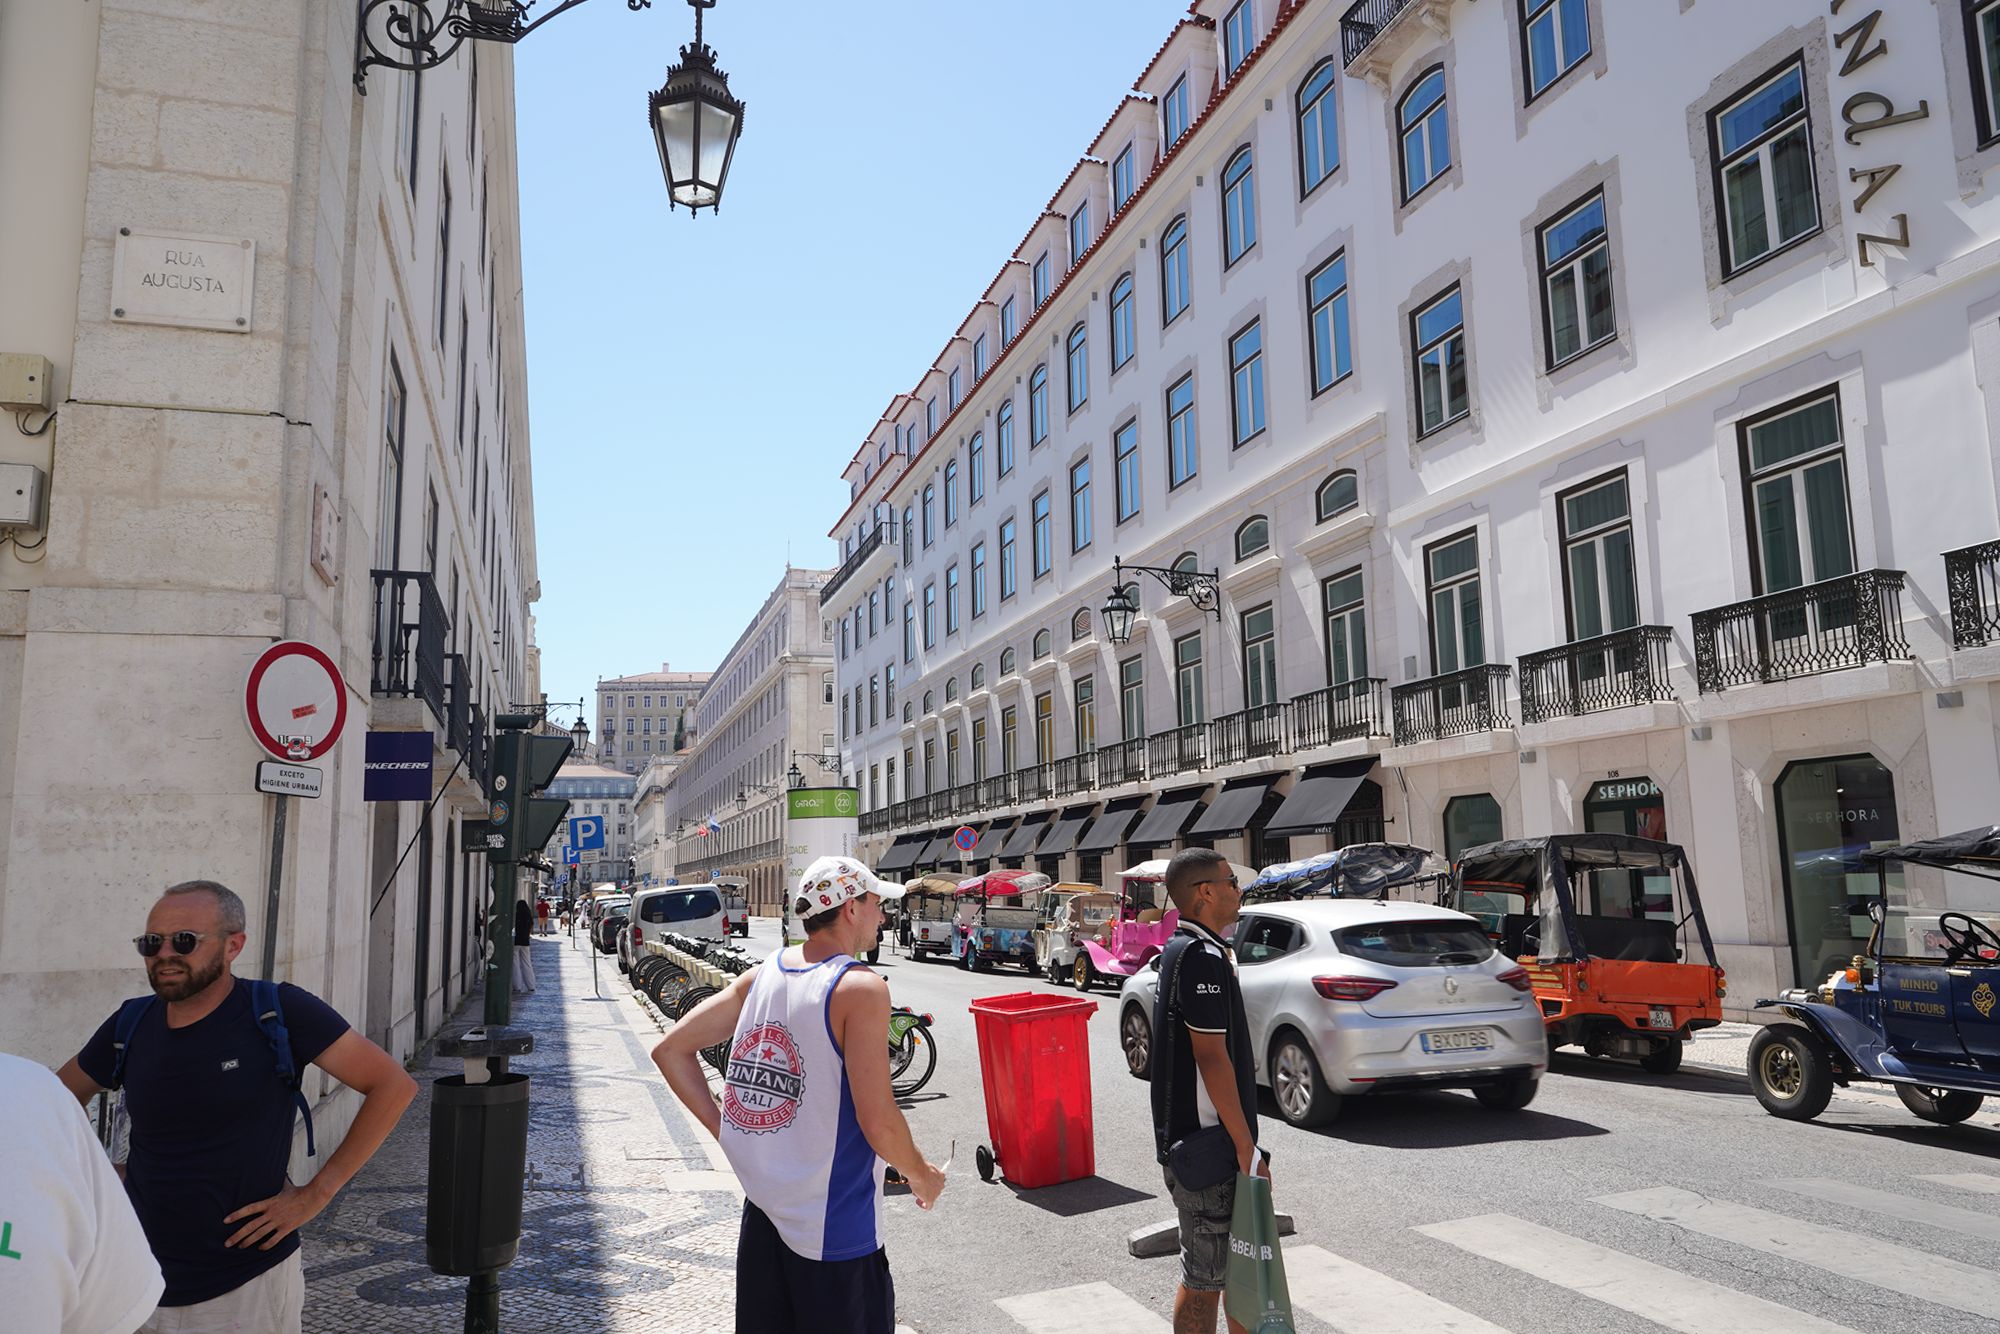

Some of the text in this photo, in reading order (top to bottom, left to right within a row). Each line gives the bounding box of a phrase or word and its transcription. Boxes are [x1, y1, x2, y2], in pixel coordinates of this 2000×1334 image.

[1831, 0, 1929, 268] NdAZ
[165, 250, 205, 268] RUA
[142, 273, 225, 293] AUGUSTA
[279, 769, 305, 779] EXCETO
[364, 762, 430, 770] SKECHERS
[1607, 770, 1620, 778] 108
[262, 779, 319, 792] HIGIENE URBANA
[1807, 808, 1879, 825] SEPHORA
[577, 820, 597, 848] P
[1900, 979, 1938, 991] MINHO
[1893, 1000, 1946, 1015] TUK TOURS
[727, 1064, 794, 1094] BINTANG
[724, 1090, 761, 1125] PILSENER
[741, 1091, 774, 1108] BALI
